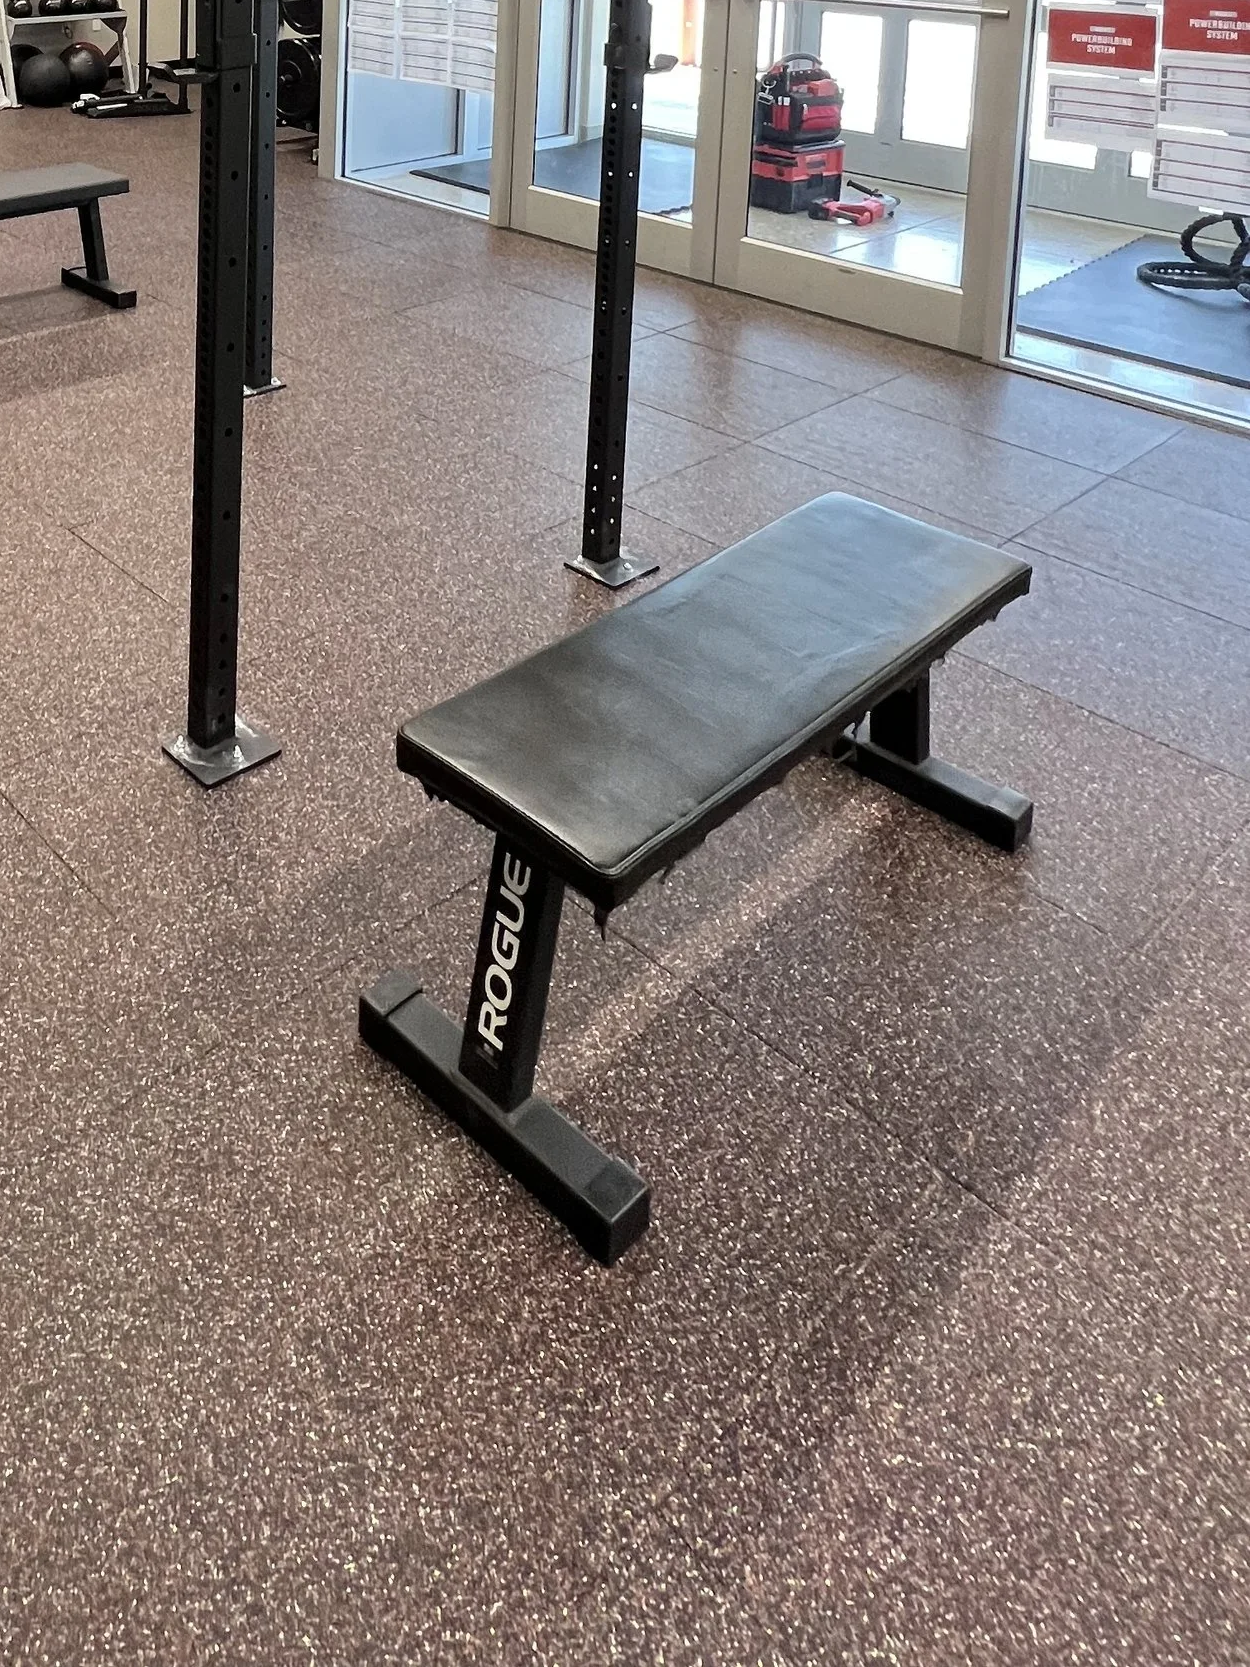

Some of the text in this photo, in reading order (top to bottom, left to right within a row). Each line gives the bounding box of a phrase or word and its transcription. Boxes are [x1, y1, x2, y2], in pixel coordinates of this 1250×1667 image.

[1189, 18, 1250, 32] POWERBUILDIN
[1071, 33, 1133, 47] POWERBUILDING
[1206, 30, 1238, 41] SYSTEM
[1086, 44, 1116, 55] SYSTEM
[477, 851, 532, 1052] ROGUE
